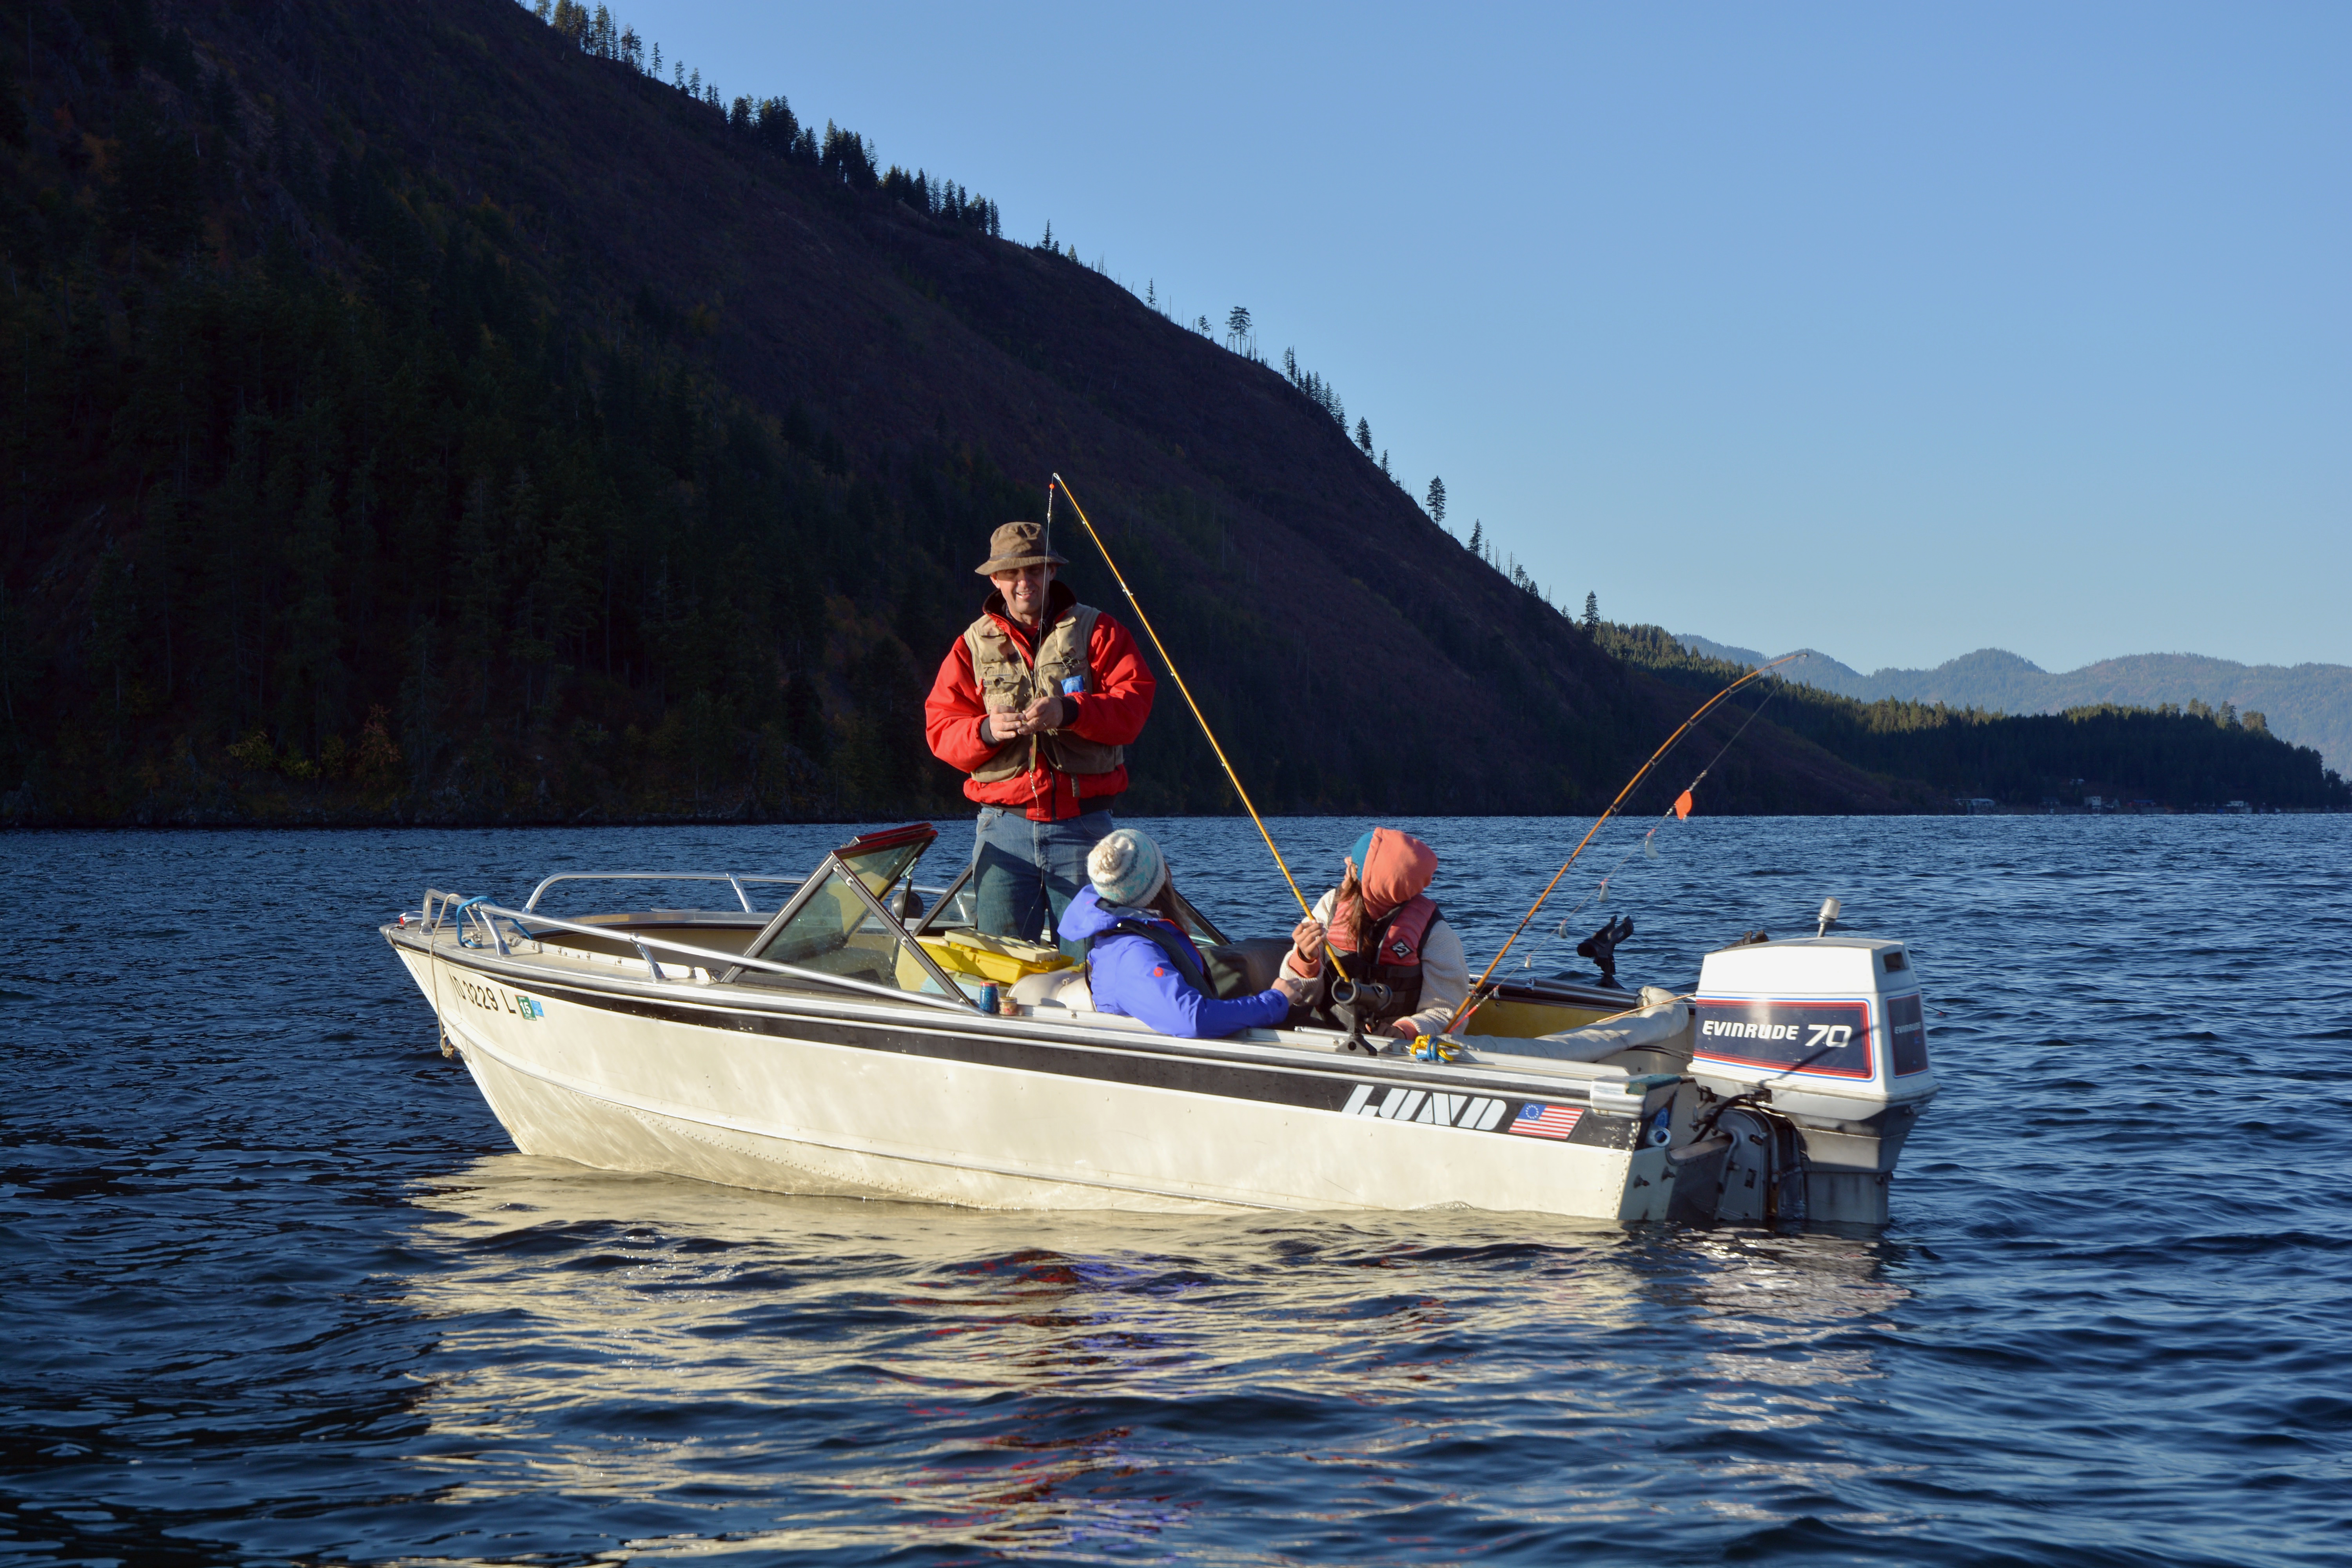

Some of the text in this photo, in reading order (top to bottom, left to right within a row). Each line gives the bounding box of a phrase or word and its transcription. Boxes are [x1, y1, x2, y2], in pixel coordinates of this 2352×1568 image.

[449, 974, 466, 1000] ID
[463, 980, 499, 1011] 3229
[500, 989, 517, 1014] L
[520, 1002, 532, 1014] 15
[1702, 1020, 1853, 1048] EVINRUDE 70
[1894, 1022, 1921, 1034] EVINRUDE
[1341, 1084, 1506, 1131] LUND
